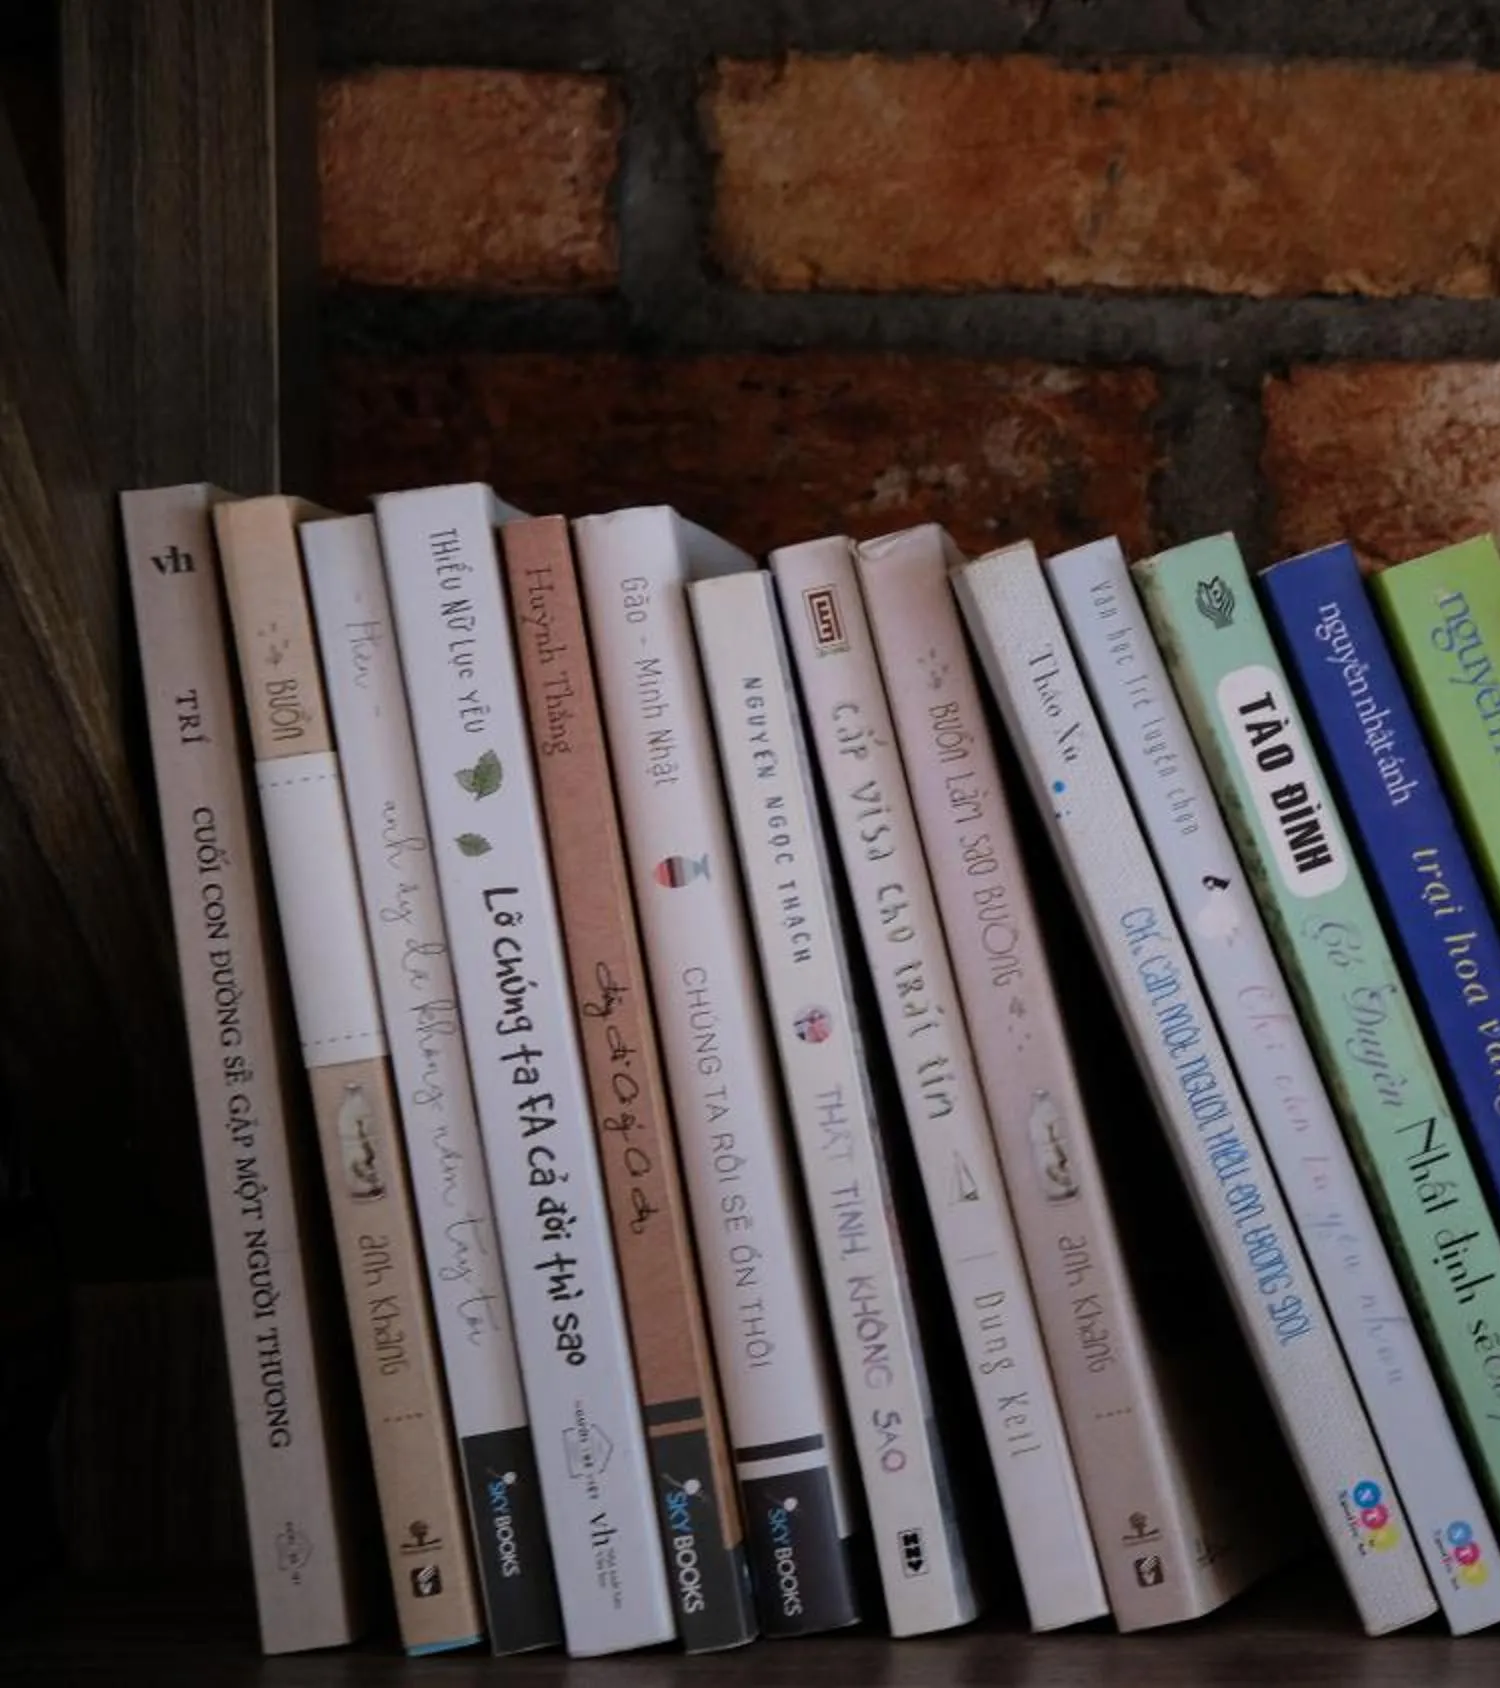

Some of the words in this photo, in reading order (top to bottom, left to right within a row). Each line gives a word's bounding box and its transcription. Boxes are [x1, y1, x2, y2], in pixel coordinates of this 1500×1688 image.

[520, 565, 568, 664] Huỳnh
[175, 688, 206, 744] TRÍ
[633, 656, 669, 719] Minh
[1237, 690, 1295, 773] TÀO
[1268, 780, 1334, 874] ĐÌNH
[1354, 695, 1395, 755] nhật
[1376, 756, 1419, 807] ánh
[191, 806, 221, 874] CUỐI
[764, 794, 794, 865] NGỌC
[201, 882, 229, 939] CON
[1410, 847, 1464, 918] trại
[1442, 930, 1489, 1005] hoa
[208, 949, 241, 1047] ĐƯỜNG
[498, 1042, 543, 1085] ta
[224, 1093, 254, 1148] GẶP
[516, 1092, 558, 1138] FA
[232, 1156, 269, 1220] MỘT
[681, 965, 723, 1076] CHÚNG
[704, 1084, 731, 1123] TA
[739, 1297, 775, 1368] THÔI
[243, 1228, 280, 1319] NGƯỜI
[533, 1251, 584, 1301] thì
[1431, 1230, 1496, 1305] định
[551, 1311, 587, 1367] sao
[871, 1408, 907, 1473] SAO
